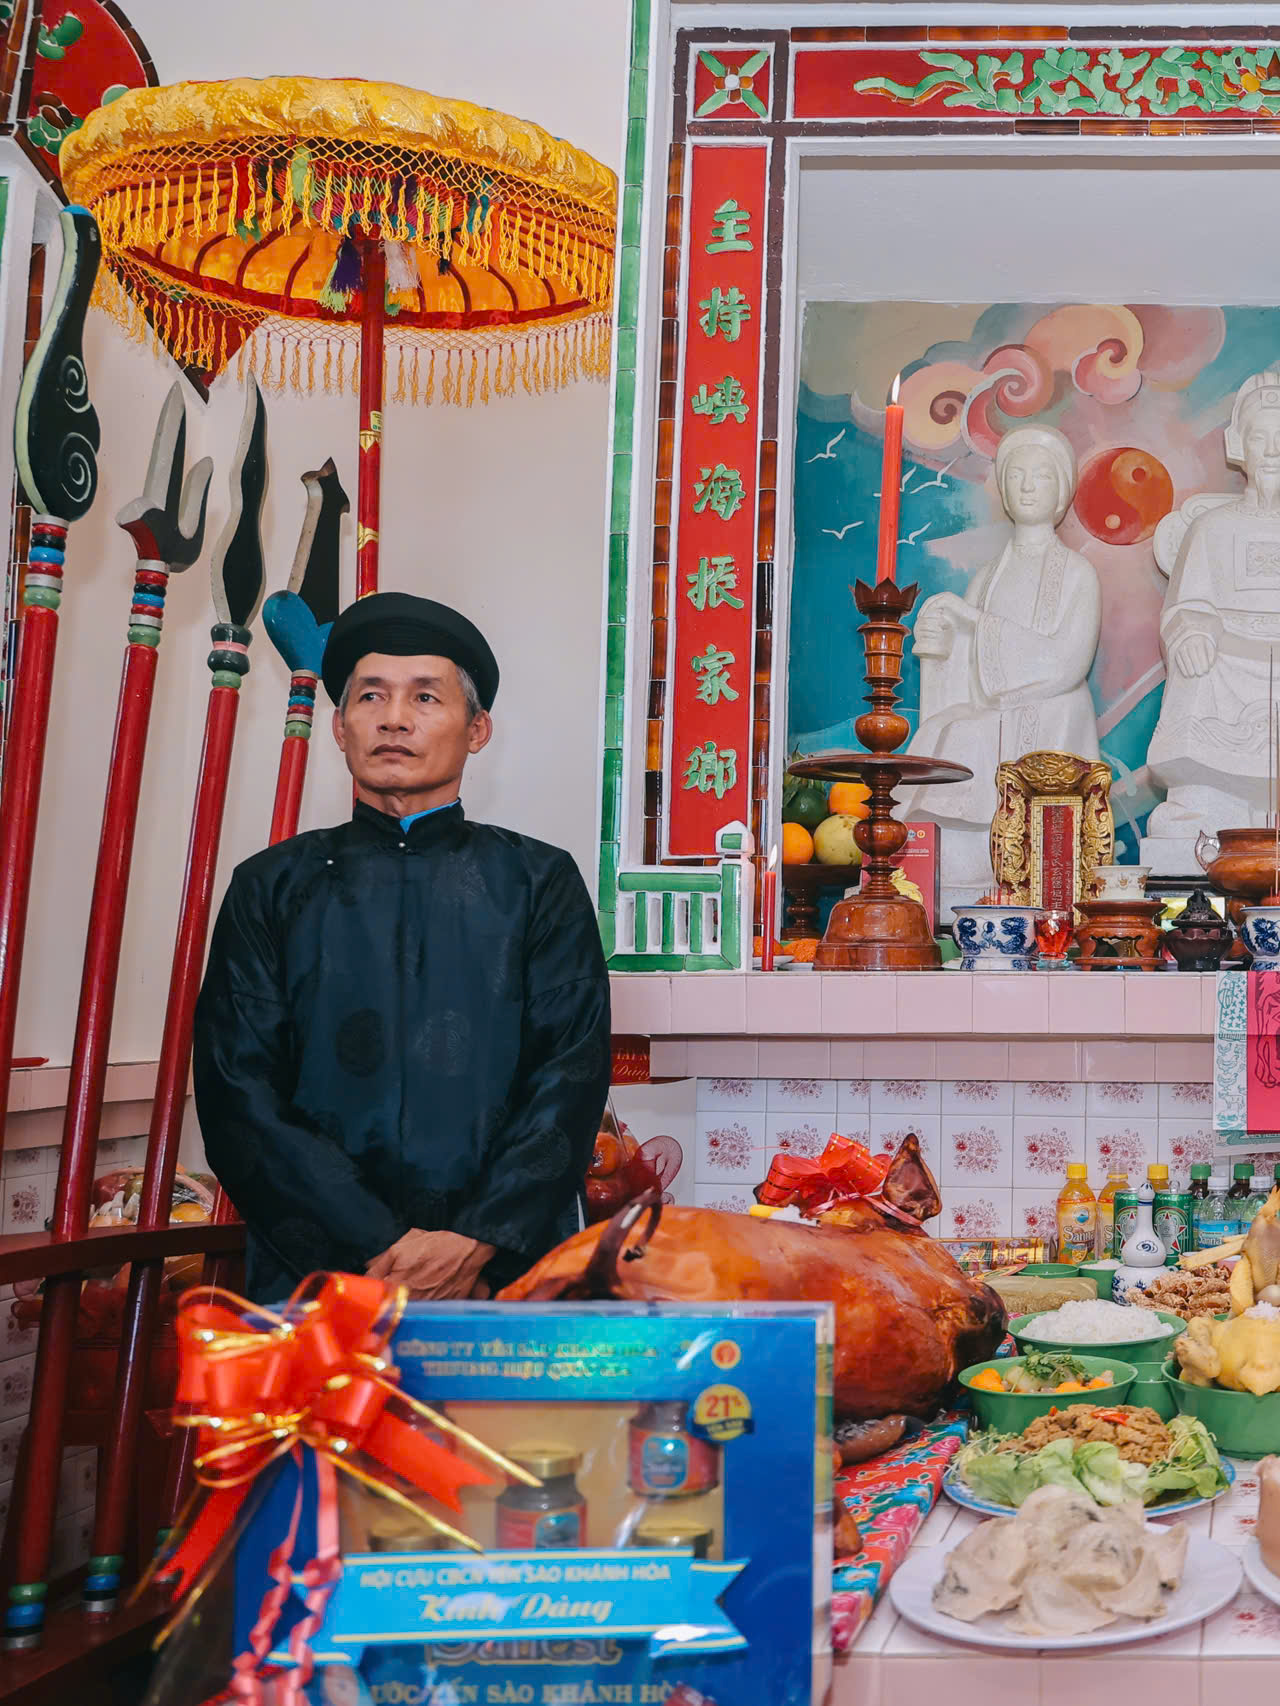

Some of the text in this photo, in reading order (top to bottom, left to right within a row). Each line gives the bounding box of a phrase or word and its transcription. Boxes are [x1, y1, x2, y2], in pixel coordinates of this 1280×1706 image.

[370, 1679, 420, 1704] ƯỚC
[486, 1680, 534, 1704] SÀO
[543, 1680, 633, 1704] KHÁNH
[640, 1679, 677, 1703] HÒ
